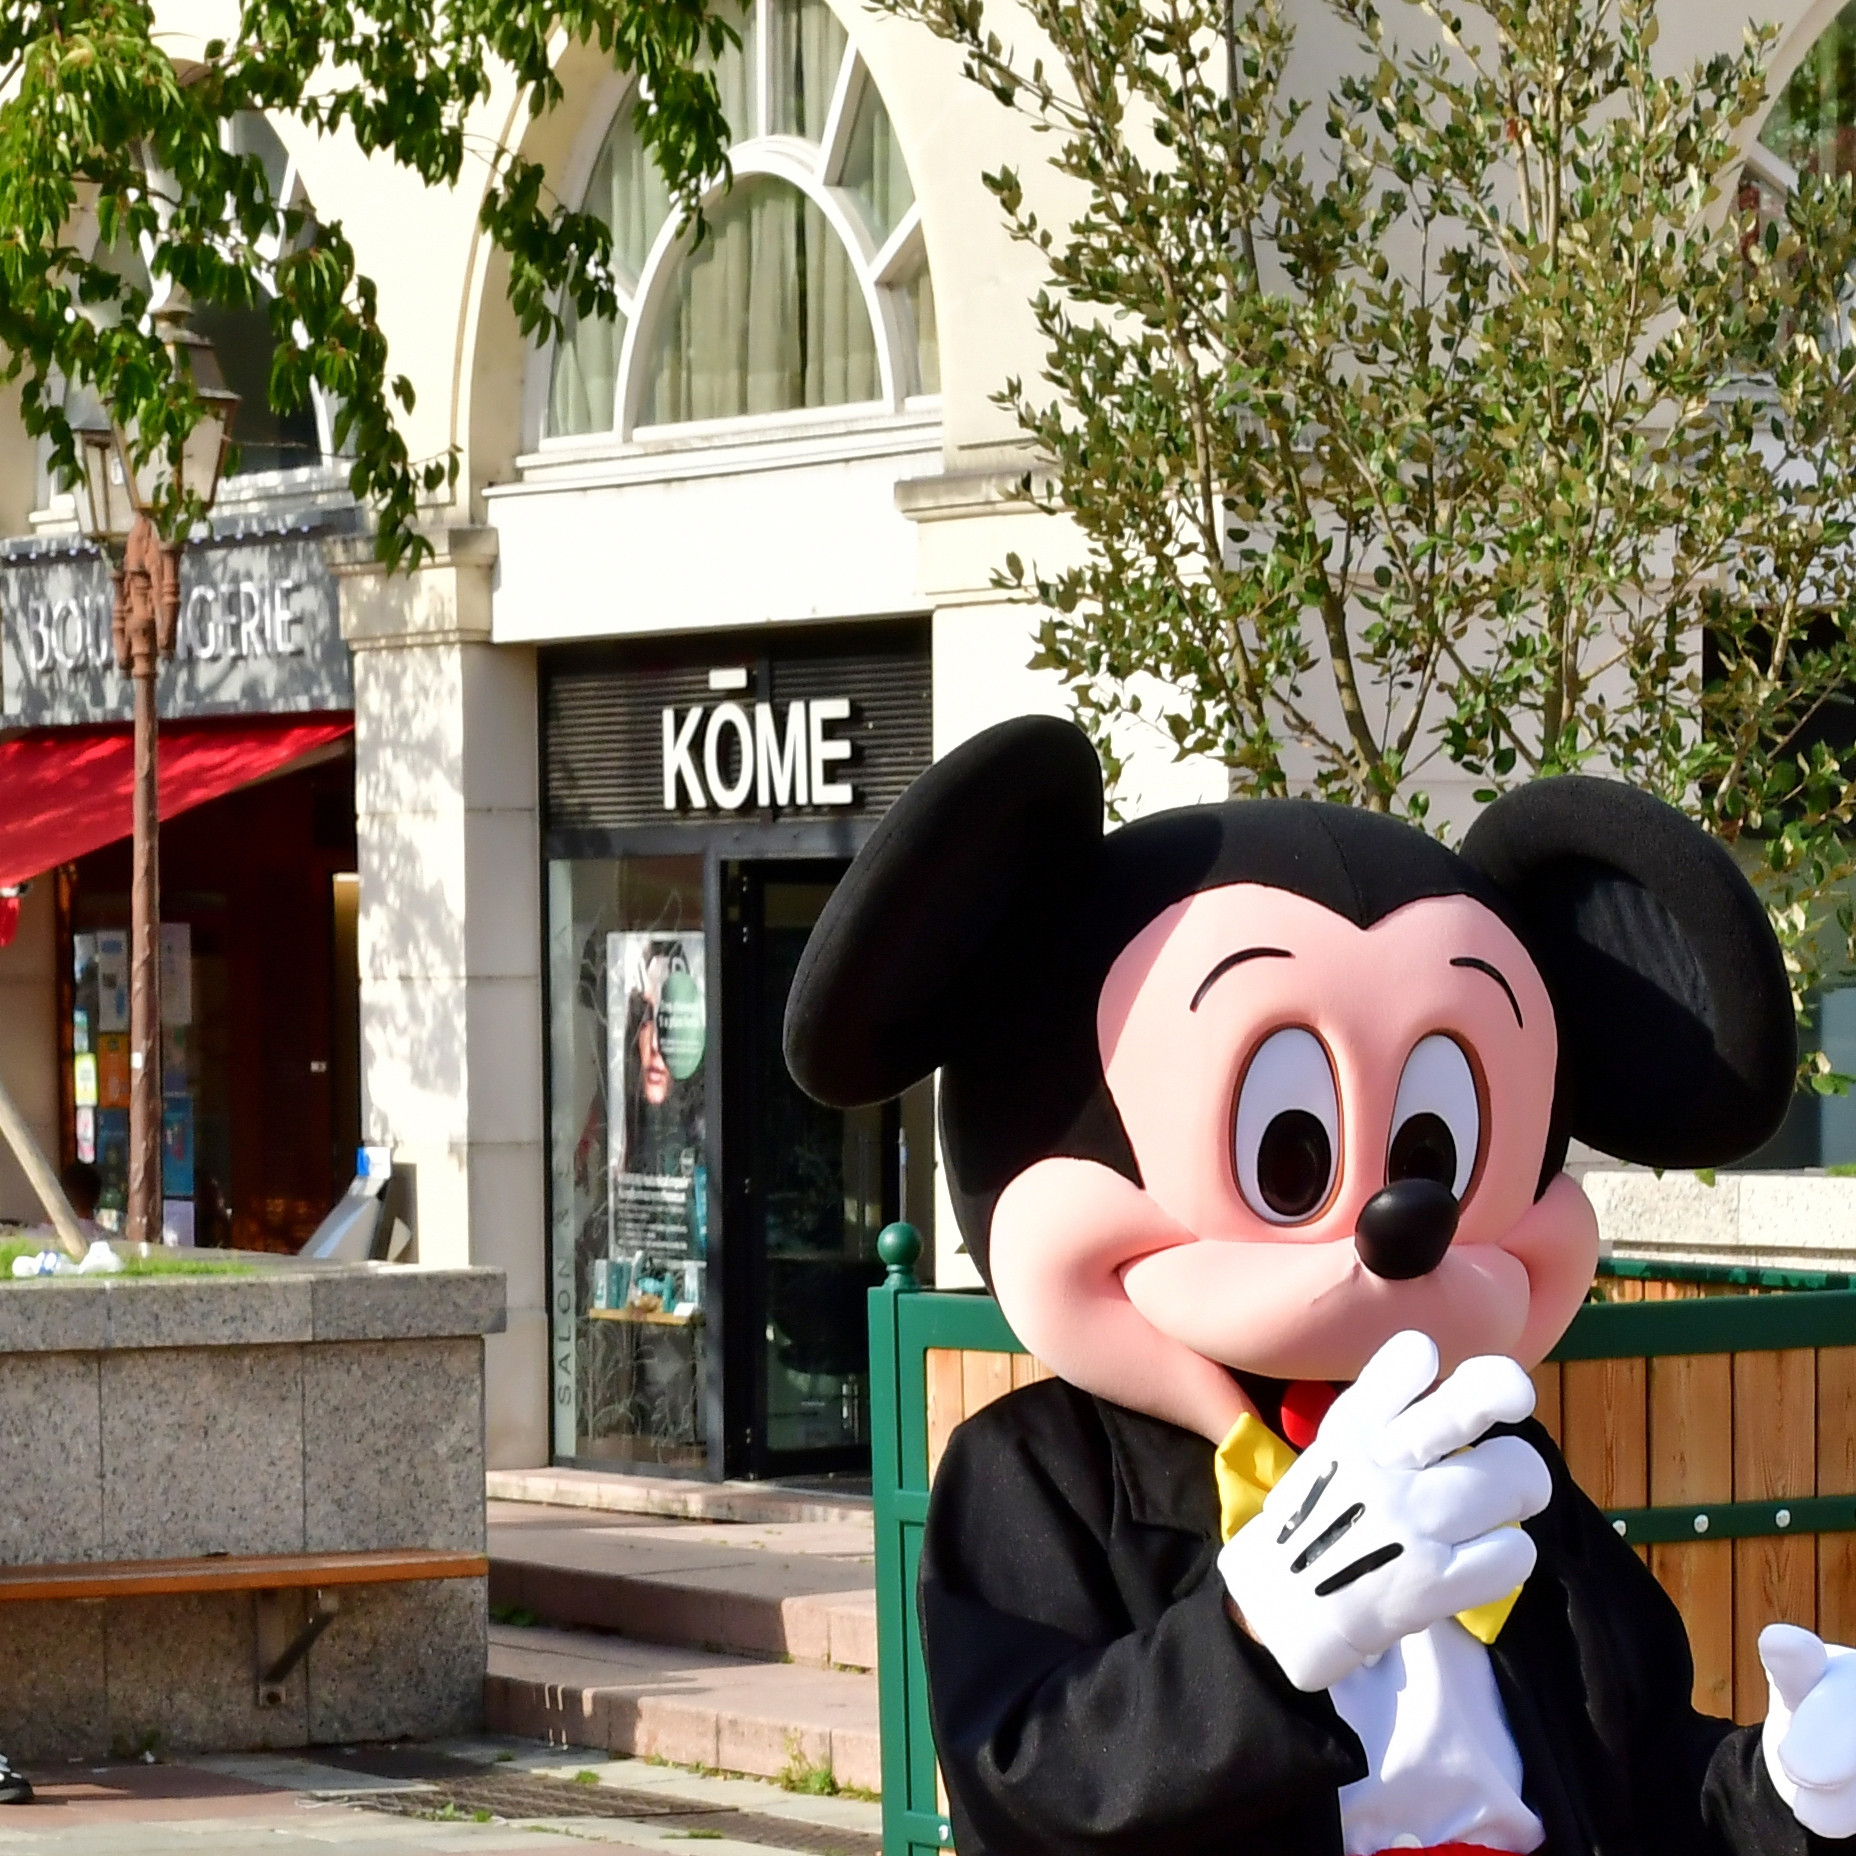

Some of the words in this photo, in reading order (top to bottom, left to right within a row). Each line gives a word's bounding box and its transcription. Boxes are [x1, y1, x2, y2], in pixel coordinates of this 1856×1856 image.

[27, 578, 296, 672] BOUGERIE
[660, 666, 855, 812] KŌME
[556, 1256, 572, 1406] SALON
